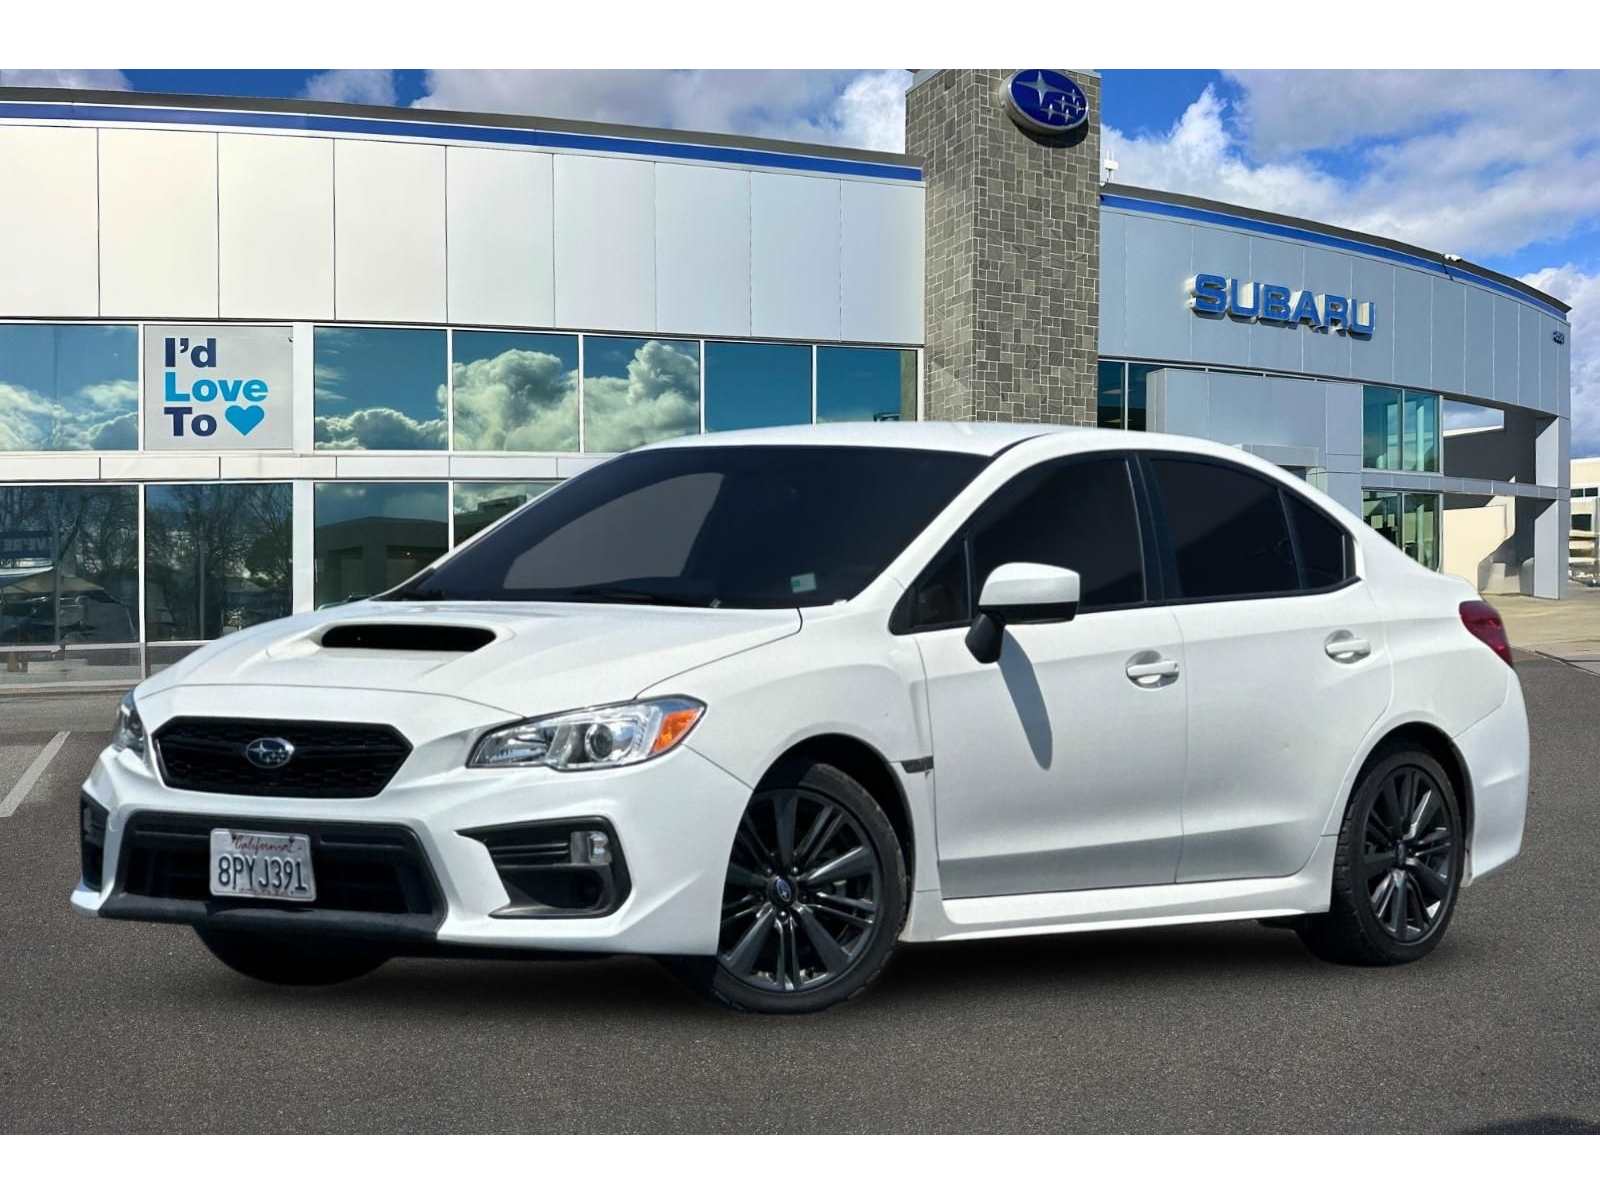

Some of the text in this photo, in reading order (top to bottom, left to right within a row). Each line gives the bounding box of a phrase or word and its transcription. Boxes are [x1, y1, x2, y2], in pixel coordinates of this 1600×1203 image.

[1192, 273, 1375, 339] SUBARU
[164, 337, 217, 368] I’d
[164, 371, 268, 402] Love
[163, 406, 217, 437] To
[218, 855, 307, 891] 8PYJ391
